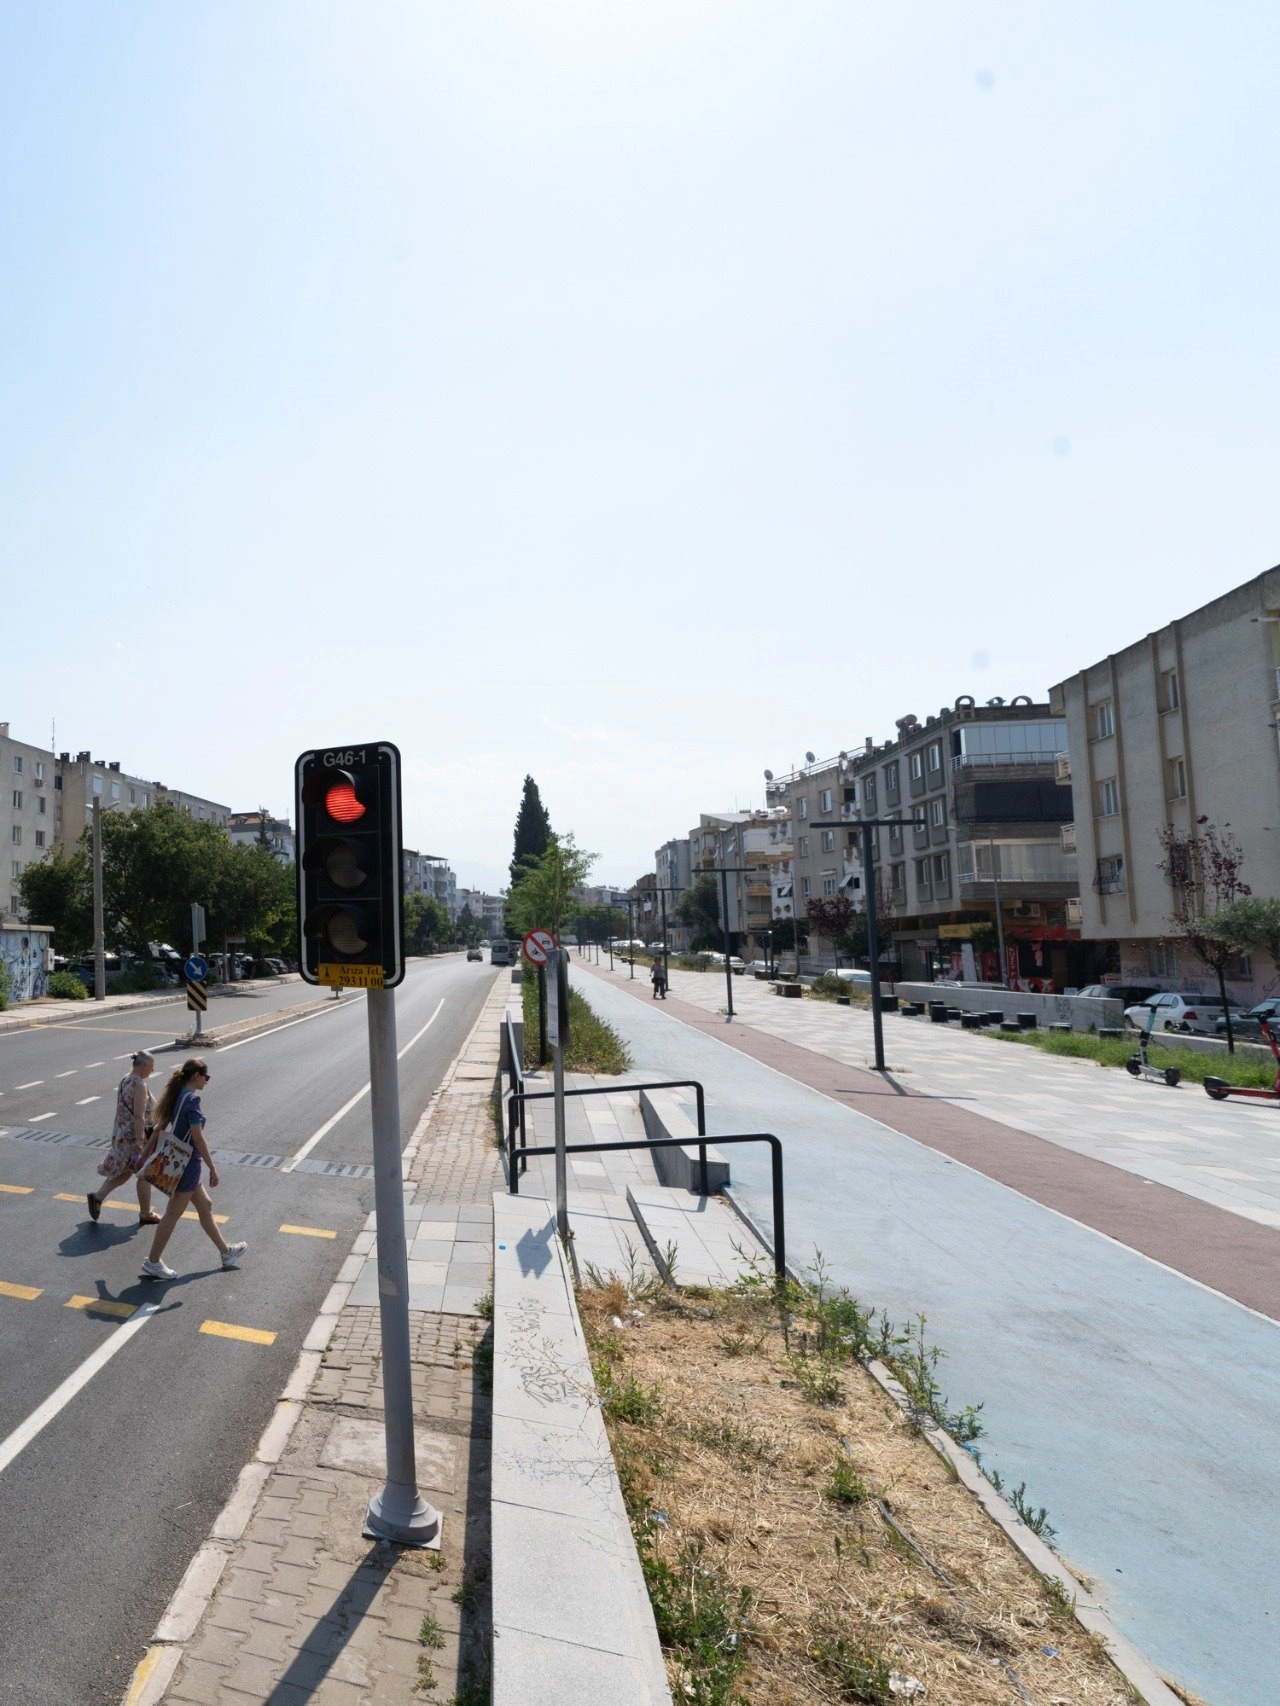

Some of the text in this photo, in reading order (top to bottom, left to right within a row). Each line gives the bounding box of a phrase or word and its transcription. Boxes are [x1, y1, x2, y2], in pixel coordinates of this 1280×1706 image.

[323, 750, 366, 767] G46-1
[339, 976, 383, 987] 293 11 00
